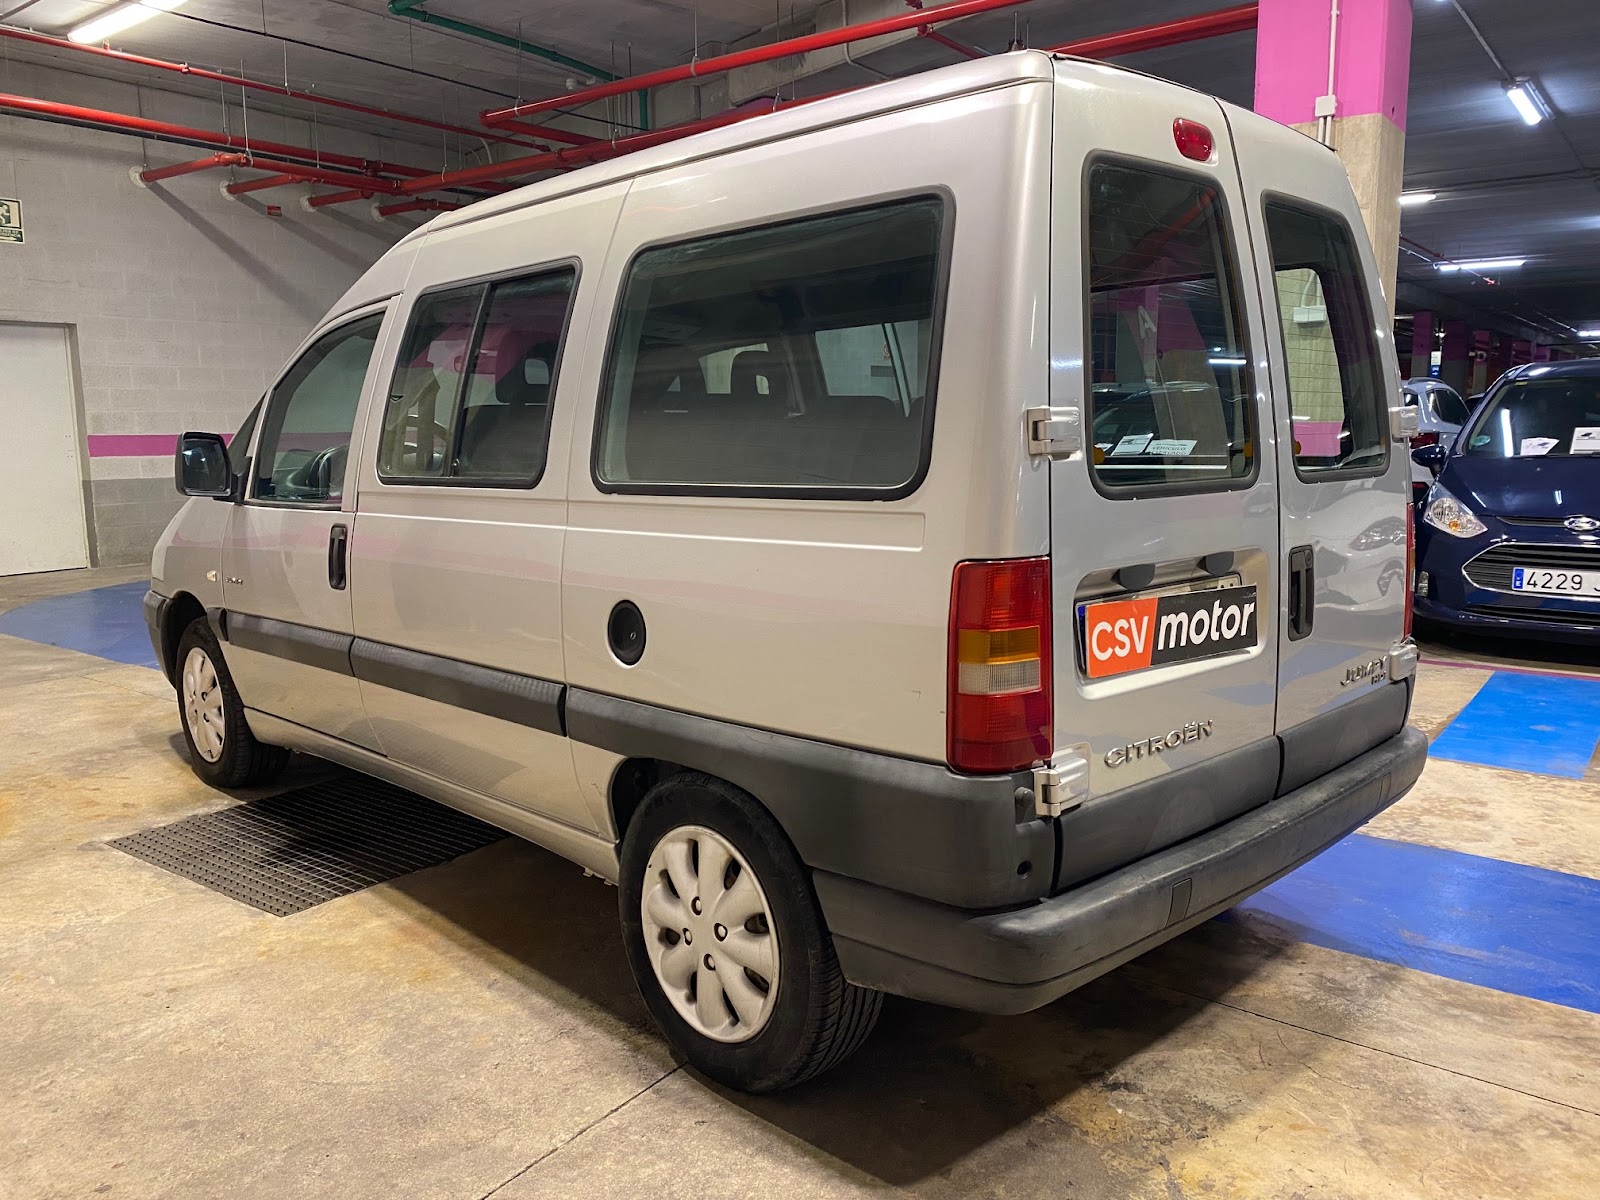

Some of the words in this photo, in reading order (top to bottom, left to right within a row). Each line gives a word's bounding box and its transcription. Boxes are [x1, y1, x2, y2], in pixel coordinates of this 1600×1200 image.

[1526, 571, 1583, 591] 4229
[1091, 615, 1149, 661] CSV
[1157, 599, 1256, 651] motor
[1103, 719, 1214, 768] CITROËN
